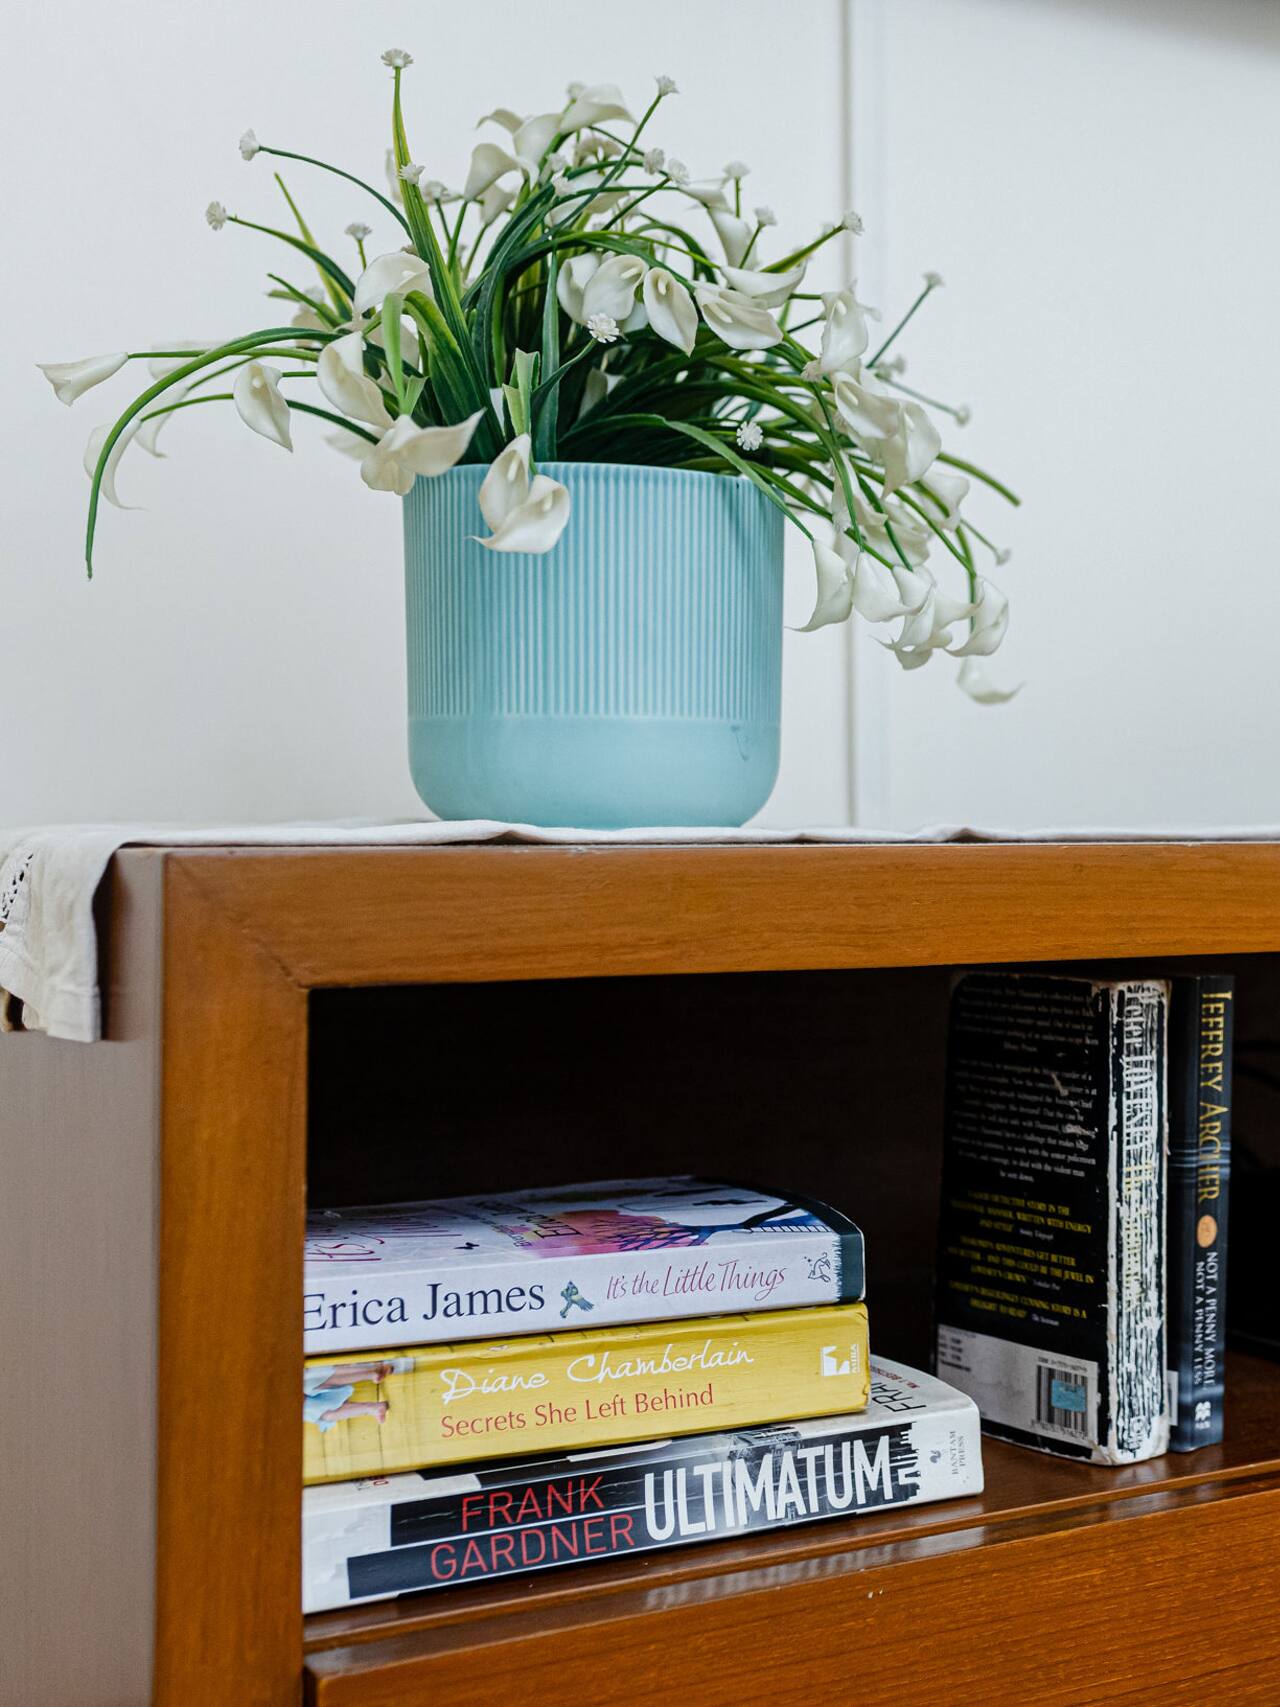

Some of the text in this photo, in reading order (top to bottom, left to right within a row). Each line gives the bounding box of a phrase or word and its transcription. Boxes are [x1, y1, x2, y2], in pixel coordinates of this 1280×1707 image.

[1198, 990, 1232, 1203] JEFFREY ARCHER
[606, 1258, 788, 1302] It's the Little Things
[1205, 1250, 1219, 1281] NOT
[1205, 1286, 1218, 1296] A
[304, 1281, 545, 1332] Erica James
[1193, 1260, 1205, 1385] NOT A PENNY LESS
[1204, 1299, 1218, 1343] PENNY
[439, 1338, 755, 1406] Diane Chamberlain
[871, 1382, 928, 1413] FRA
[440, 1382, 715, 1440] Secrets She Left Behind
[948, 1430, 960, 1476] BANTAM
[958, 1434, 967, 1468] PRESS
[461, 1474, 606, 1532] FRANK
[643, 1434, 896, 1542] ULTIMATUM
[429, 1512, 636, 1581] GARDNER
